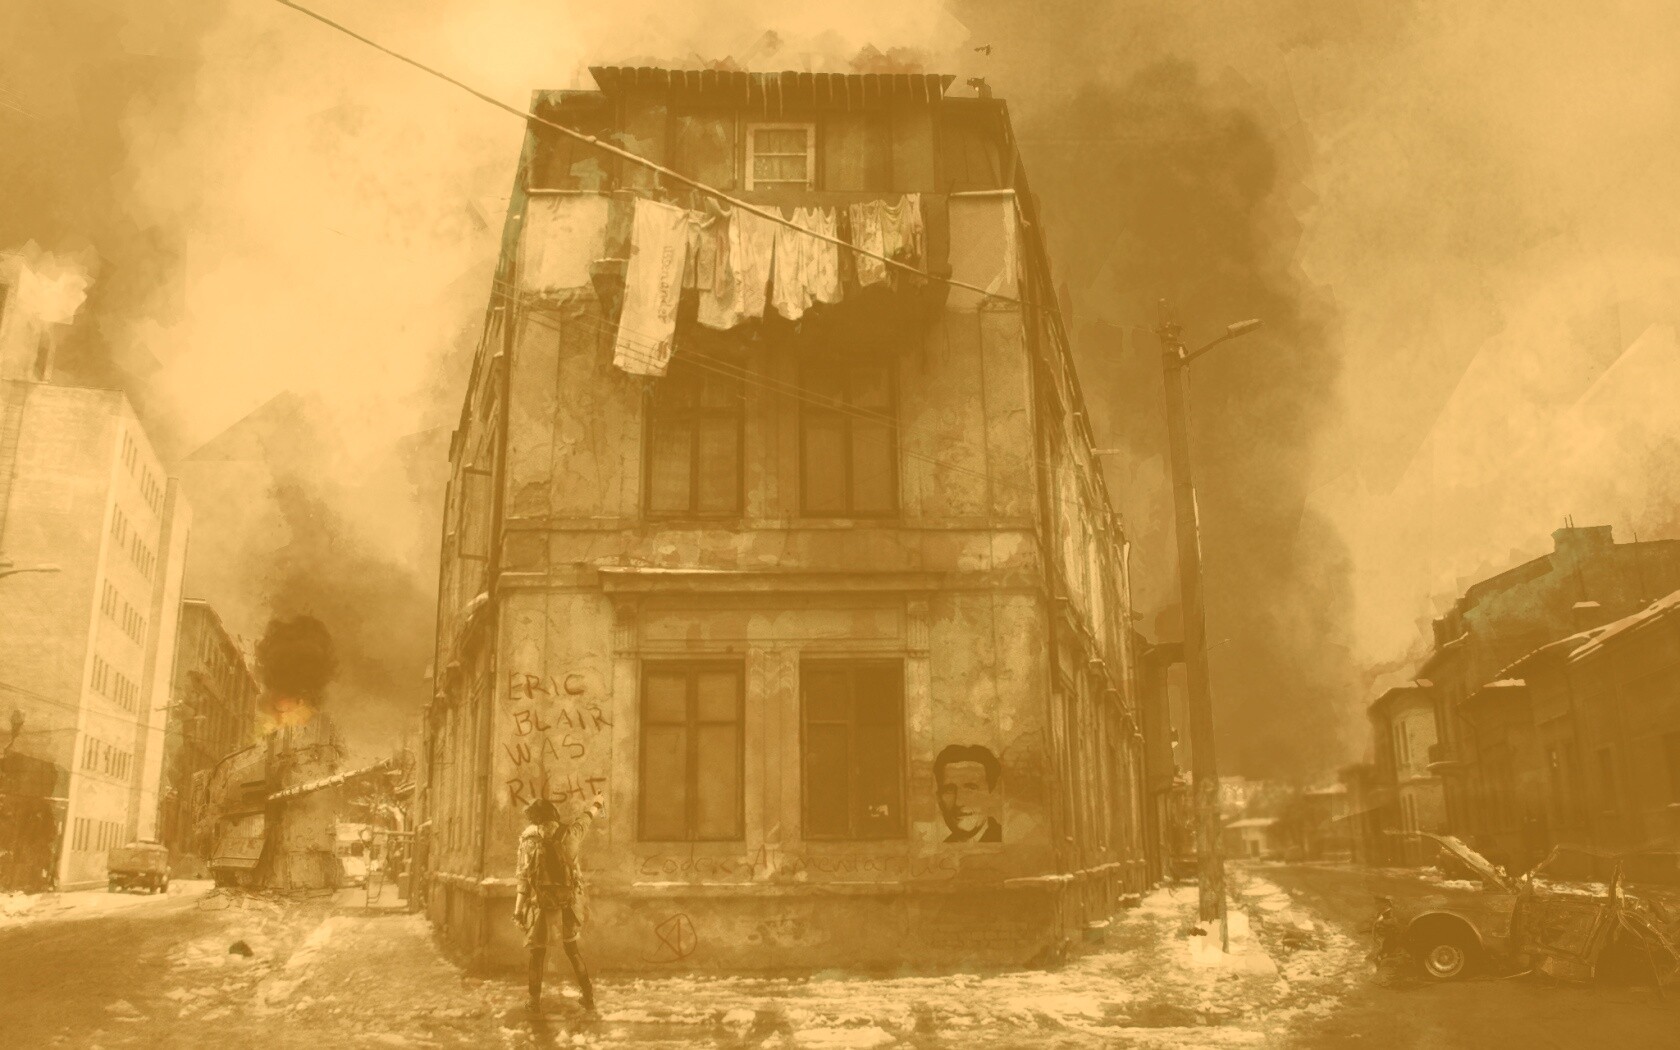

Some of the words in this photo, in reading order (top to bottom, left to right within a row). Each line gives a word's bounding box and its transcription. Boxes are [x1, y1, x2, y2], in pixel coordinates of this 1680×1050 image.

[508, 669, 585, 700] ERIC
[513, 706, 614, 736] BLAIR
[502, 733, 585, 766] WAS
[506, 774, 606, 807] RIGHT
